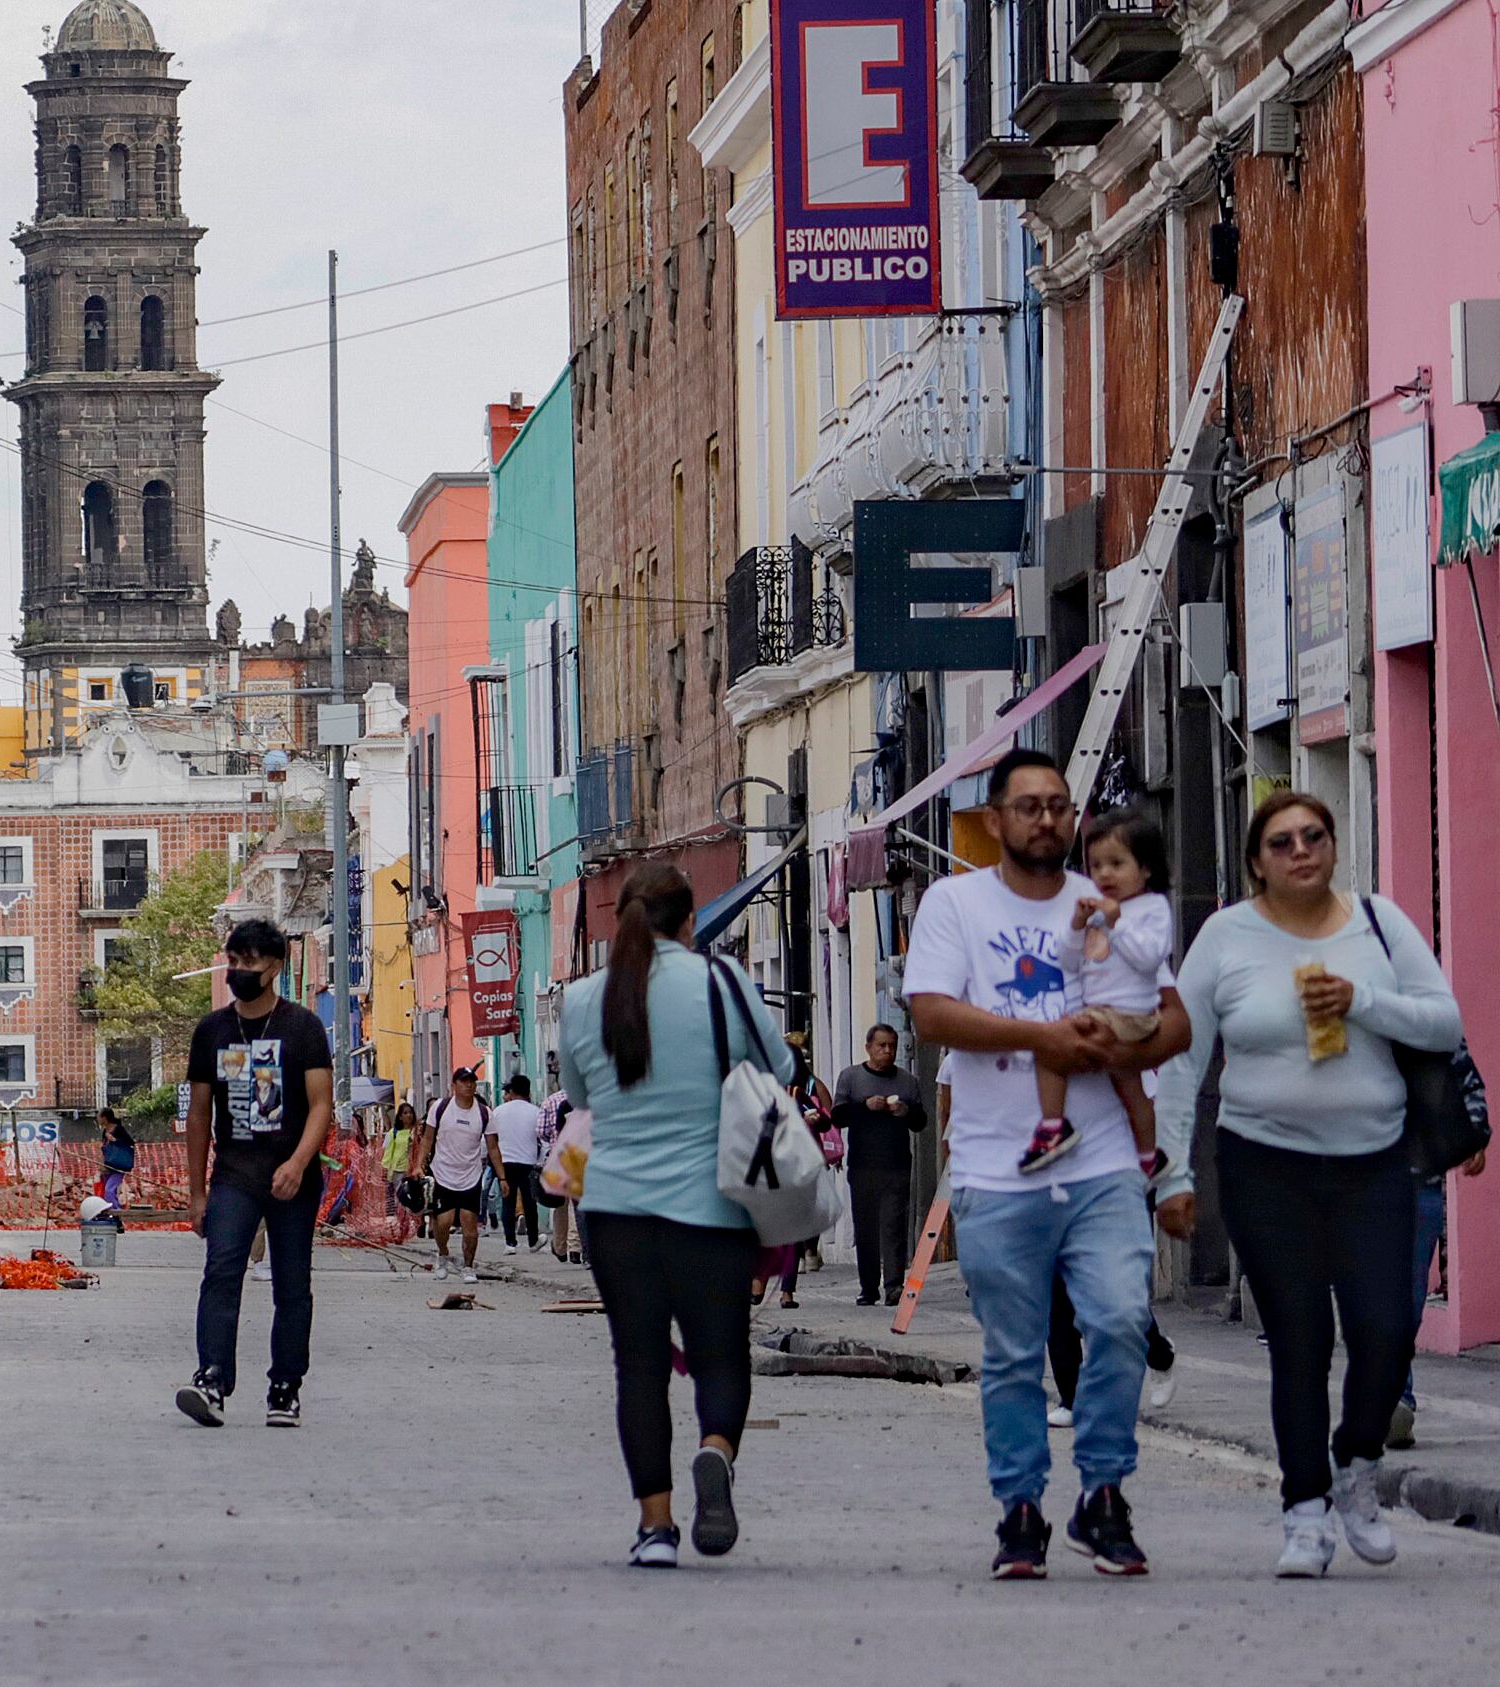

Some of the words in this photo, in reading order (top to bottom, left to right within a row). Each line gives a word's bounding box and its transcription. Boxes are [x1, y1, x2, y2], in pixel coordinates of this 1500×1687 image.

[799, 18, 910, 211] E
[785, 225, 929, 253] ESTACIONAMIENTO
[787, 255, 929, 283] PUBLICO
[473, 990, 513, 1005] Copias
